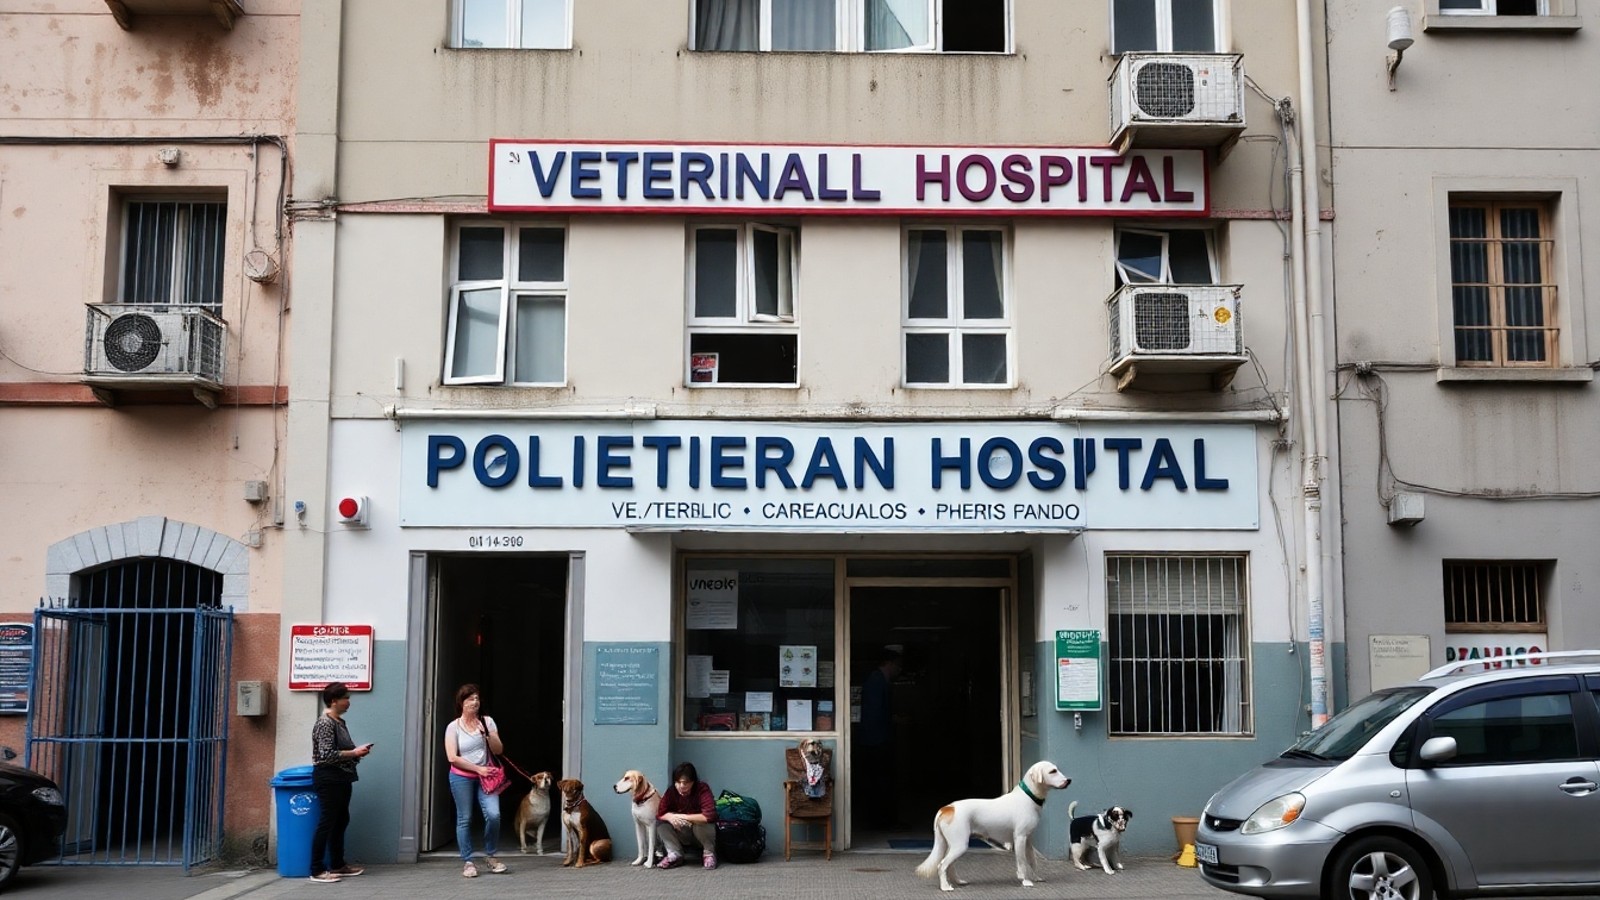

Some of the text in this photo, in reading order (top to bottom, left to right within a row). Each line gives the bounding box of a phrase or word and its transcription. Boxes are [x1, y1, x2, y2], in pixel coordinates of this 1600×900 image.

[528, 151, 1195, 203] VETERINALL HOSPITAL
[427, 434, 895, 489] POLIETIERAN
[762, 502, 907, 520] CAREACUALOS
[936, 503, 1006, 520] PHERIS
